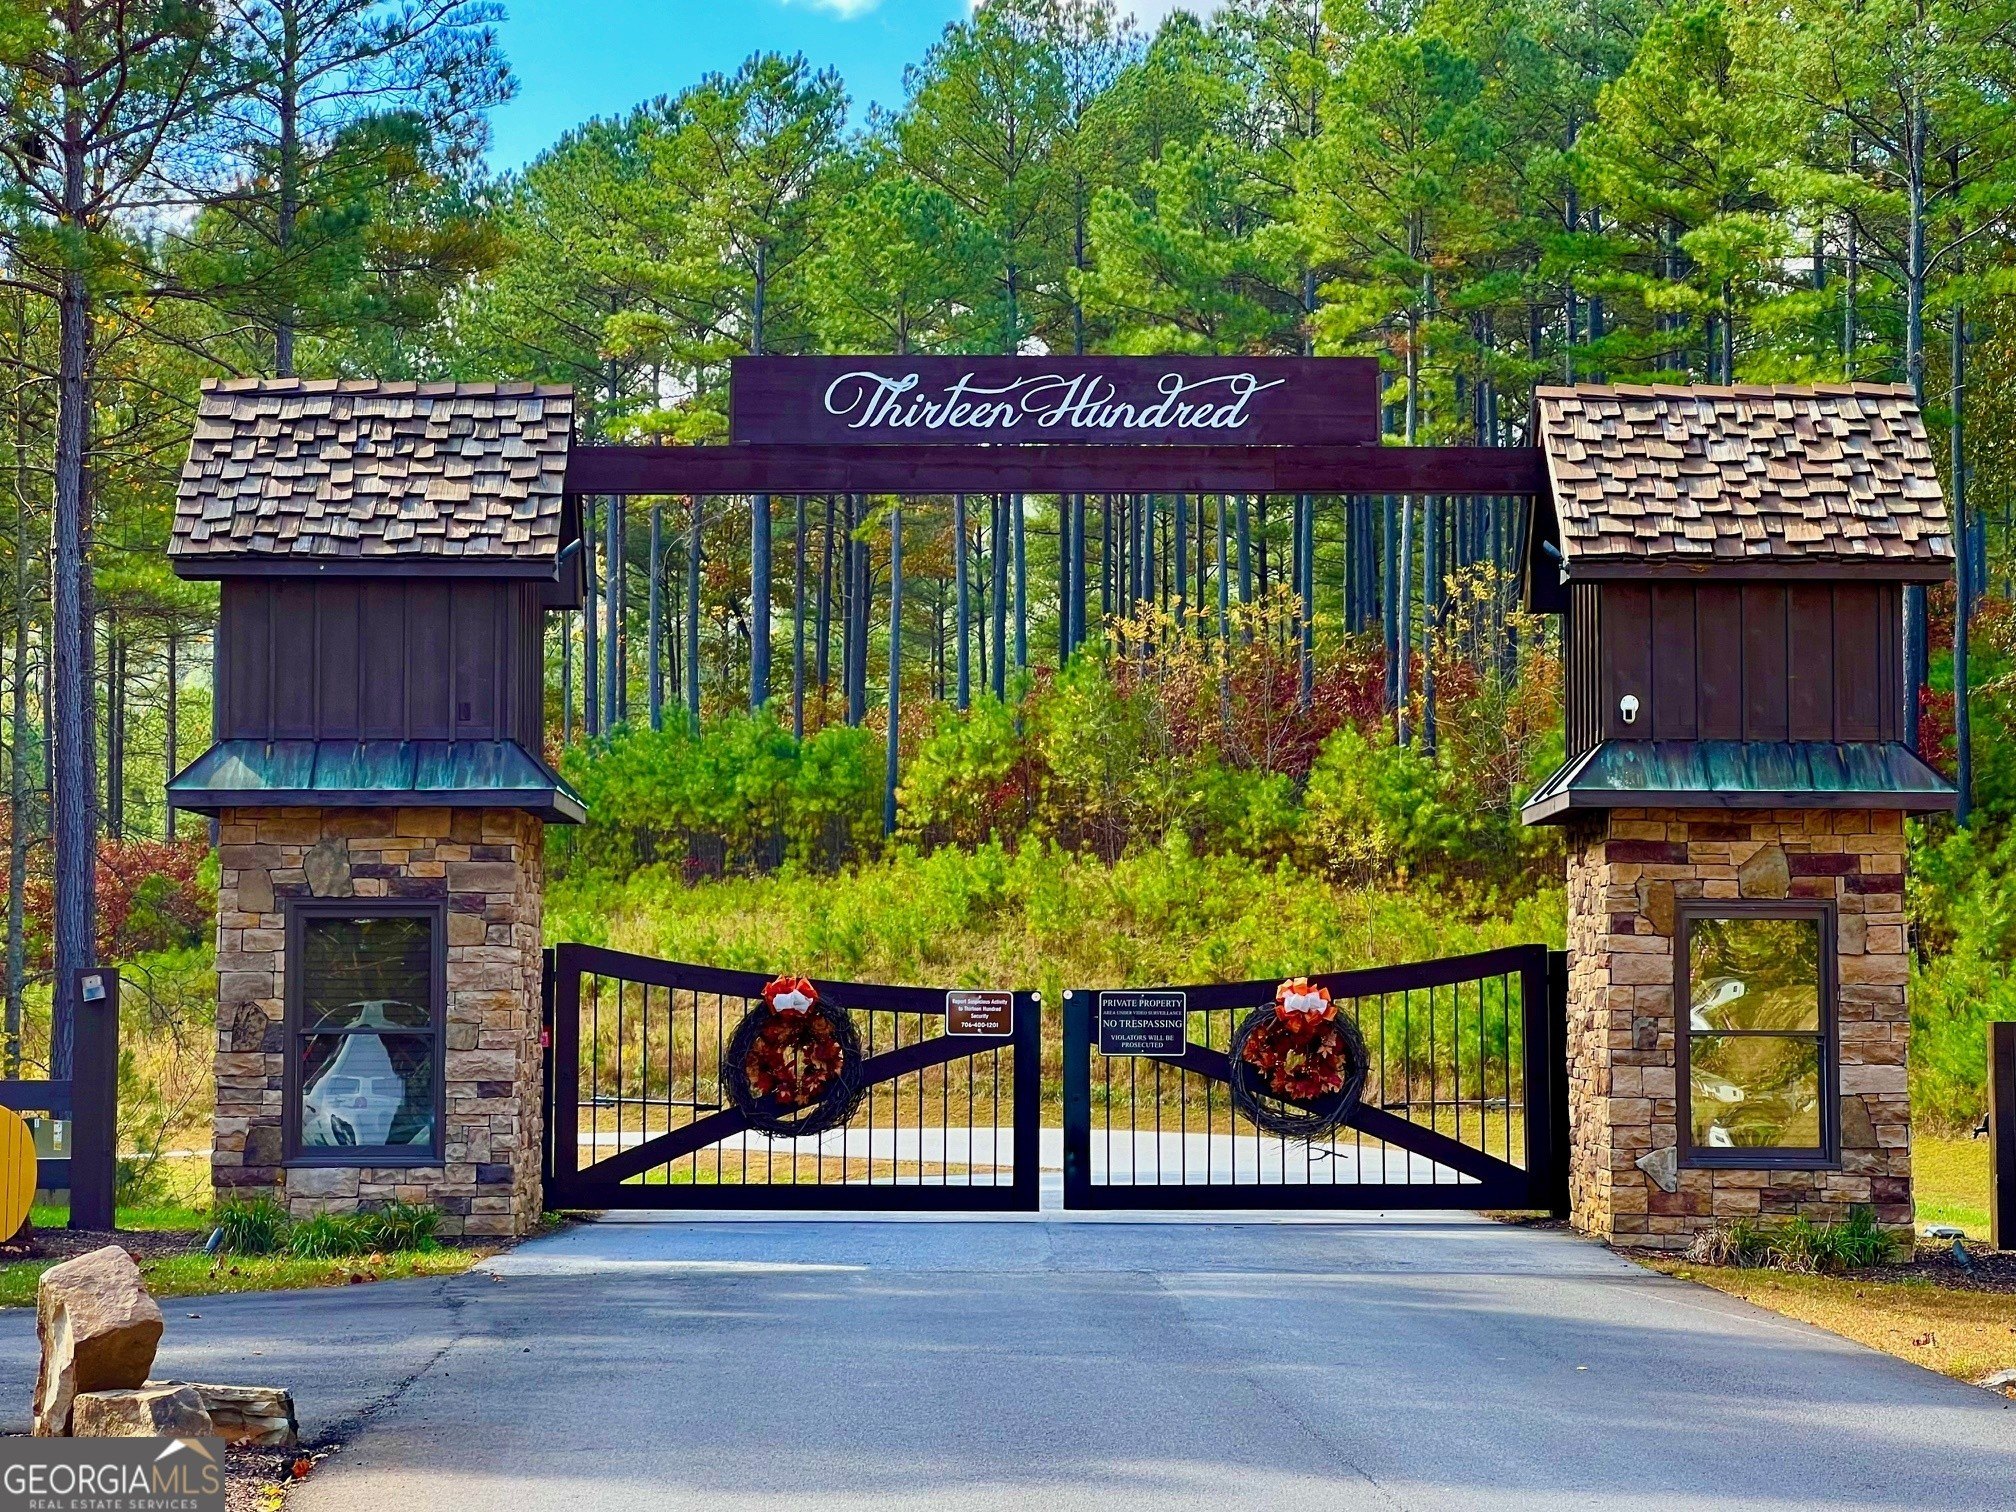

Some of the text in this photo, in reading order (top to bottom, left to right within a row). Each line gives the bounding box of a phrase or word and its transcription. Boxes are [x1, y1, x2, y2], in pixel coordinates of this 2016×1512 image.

[824, 371, 1286, 428] Thirteen Hundred
[1103, 1020, 1182, 1028] NO TRESPASSING
